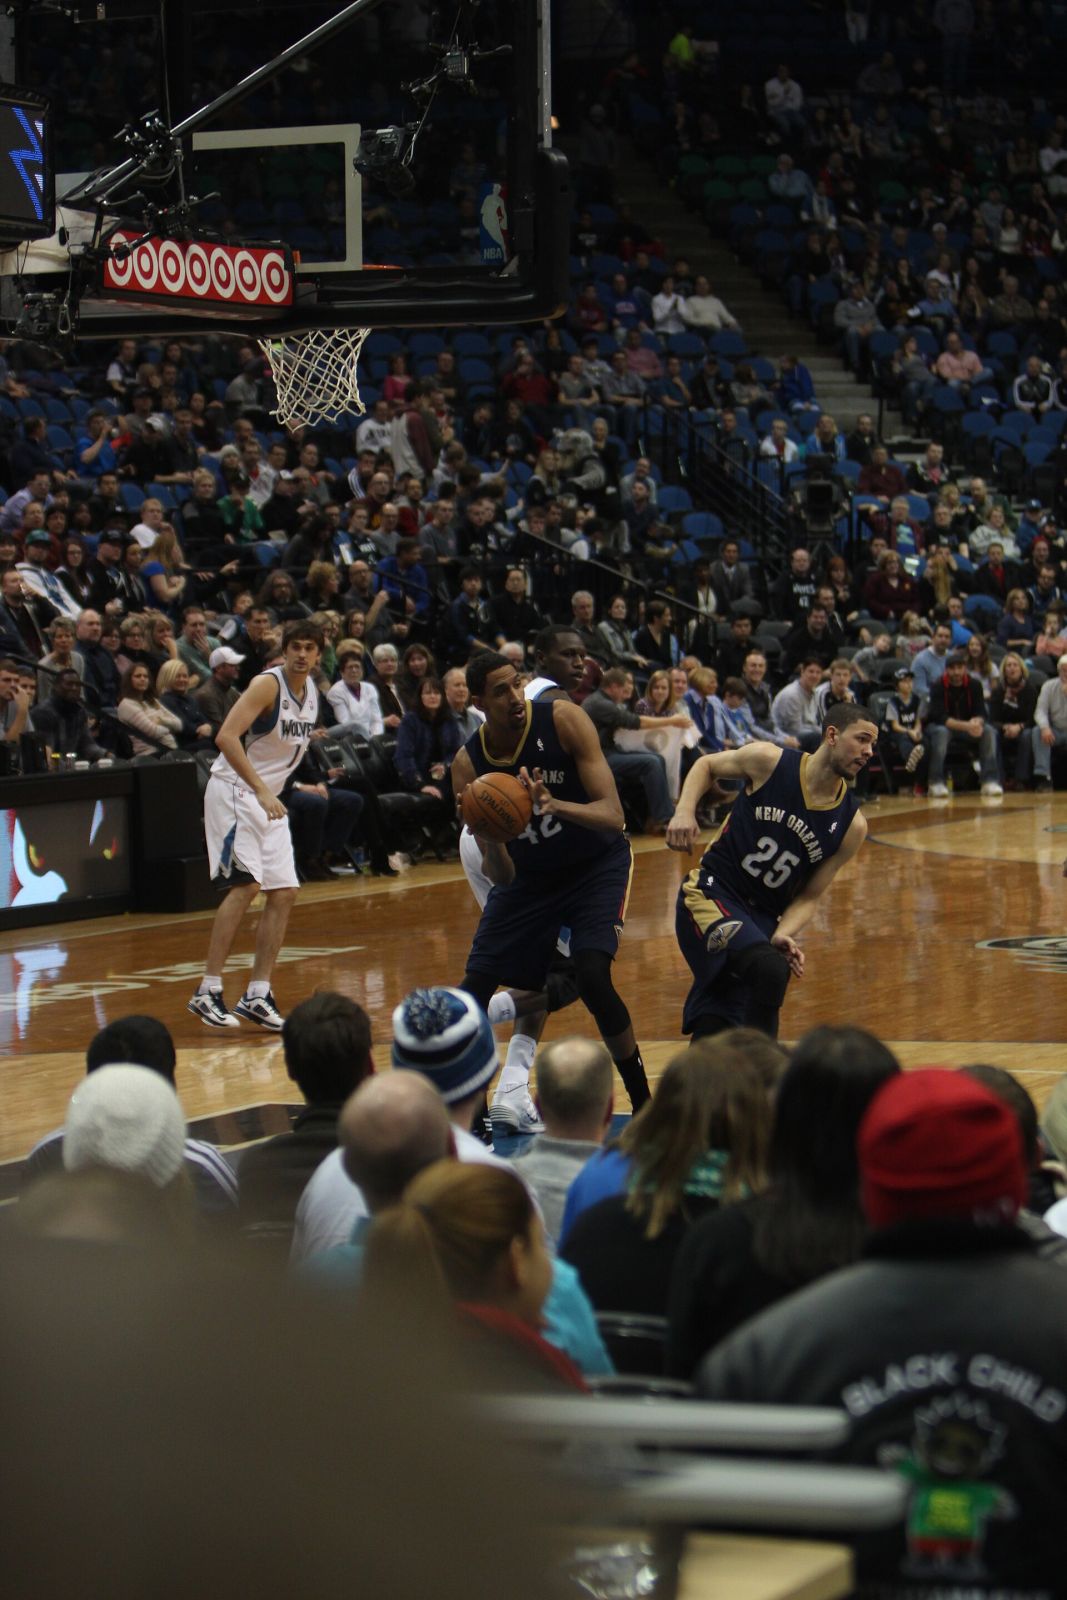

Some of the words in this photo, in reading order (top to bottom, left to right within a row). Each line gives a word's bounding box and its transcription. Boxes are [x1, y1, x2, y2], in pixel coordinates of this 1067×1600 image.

[483, 247, 503, 260] NBA
[280, 719, 315, 739] WOLVE
[754, 805, 786, 824] NEW
[786, 814, 824, 864] ORLEANS
[740, 835, 801, 889] 25
[840, 1352, 960, 1417] BLACK
[966, 1352, 1067, 1423] CHILD
